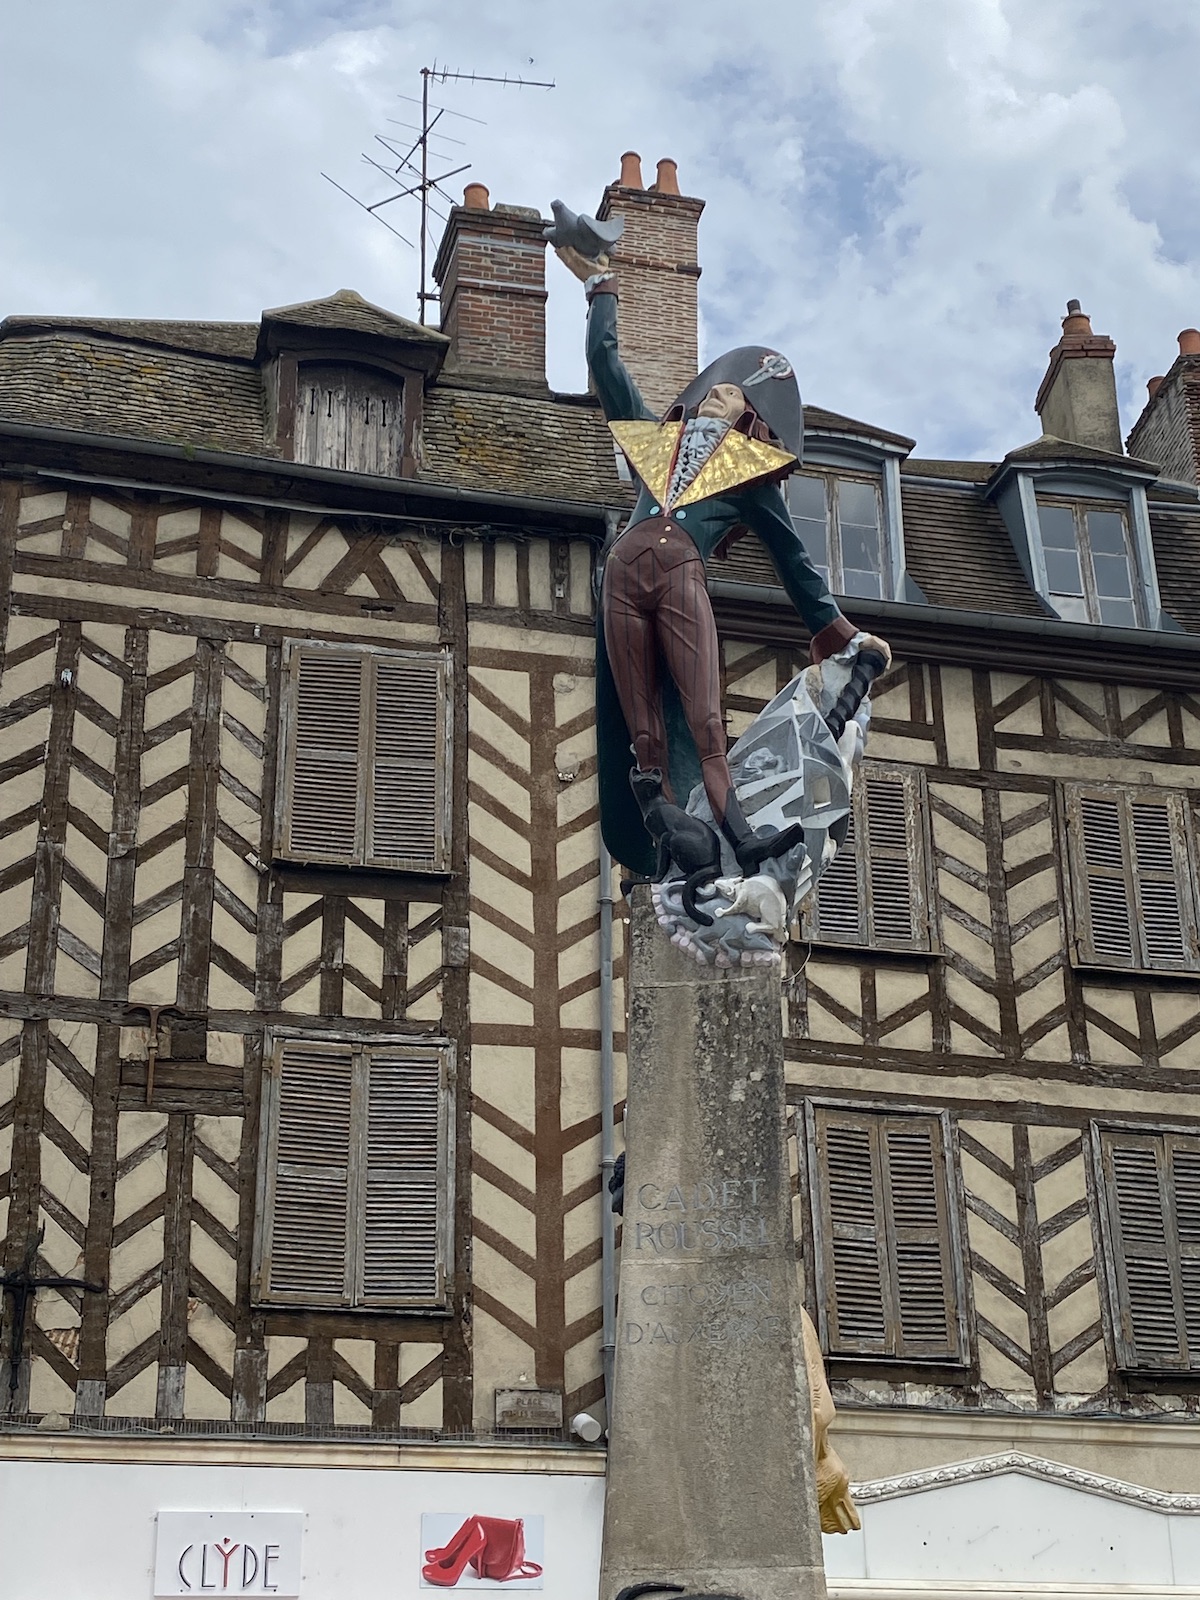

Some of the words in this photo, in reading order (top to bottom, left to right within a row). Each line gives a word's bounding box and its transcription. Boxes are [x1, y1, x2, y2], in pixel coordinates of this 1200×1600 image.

[638, 1179, 766, 1212] CADET
[635, 1218, 777, 1253] ROUSSEL
[641, 1278, 773, 1305] CITOYEN
[178, 1543, 280, 1589] CLYDE
